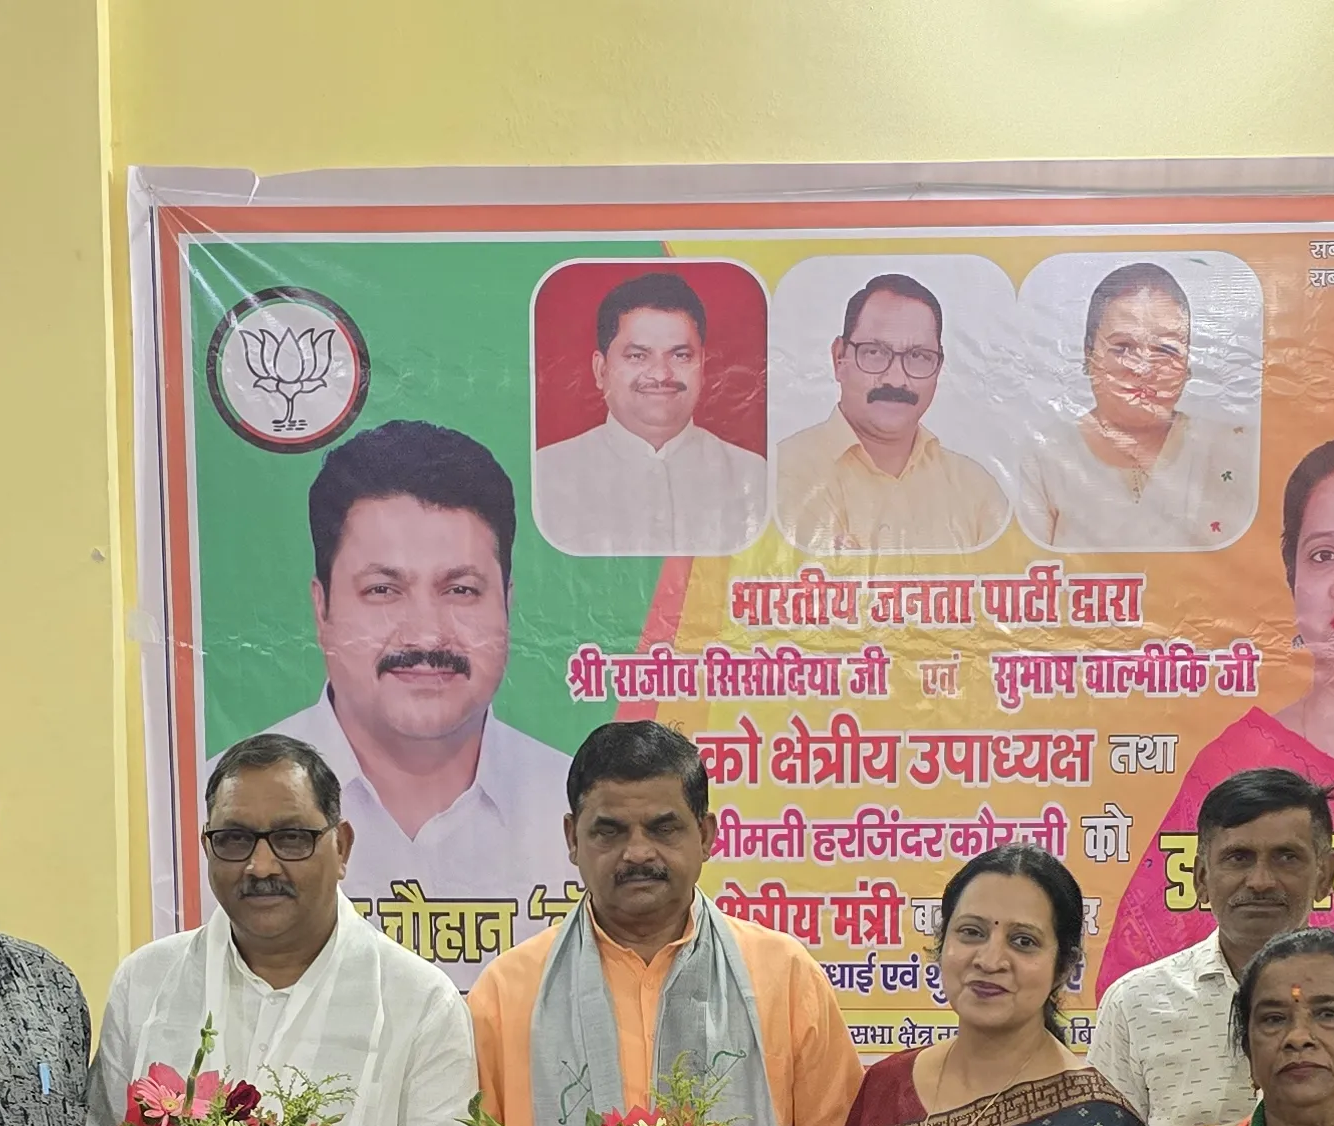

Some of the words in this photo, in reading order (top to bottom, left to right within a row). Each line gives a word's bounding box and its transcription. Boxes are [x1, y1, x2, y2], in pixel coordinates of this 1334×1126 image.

[731, 567, 862, 627] भारतीय
[866, 578, 976, 625] जनता
[979, 564, 1062, 624] पार्टी
[1067, 577, 1144, 624] द्वारा
[567, 647, 607, 698] श्री
[610, 647, 700, 698] राजीव
[702, 645, 843, 697] सिसोदिया
[846, 644, 891, 696] जी
[918, 652, 961, 697] एवं
[991, 653, 1078, 710] सुभाष
[1082, 642, 1212, 695] वाल्मीकि
[1214, 642, 1261, 693] जी
[695, 715, 763, 785] को
[770, 713, 903, 786] क्षेत्रीय
[907, 732, 1096, 786] उपाध्यक्ष
[1107, 733, 1177, 775] तथा
[812, 807, 946, 860] हरजिंदर
[1080, 802, 1134, 863] को
[830, 880, 906, 946] मंत्री
[822, 952, 877, 993] धाई
[880, 953, 919, 991] एवं
[898, 1017, 935, 1047] क्षेत्र
